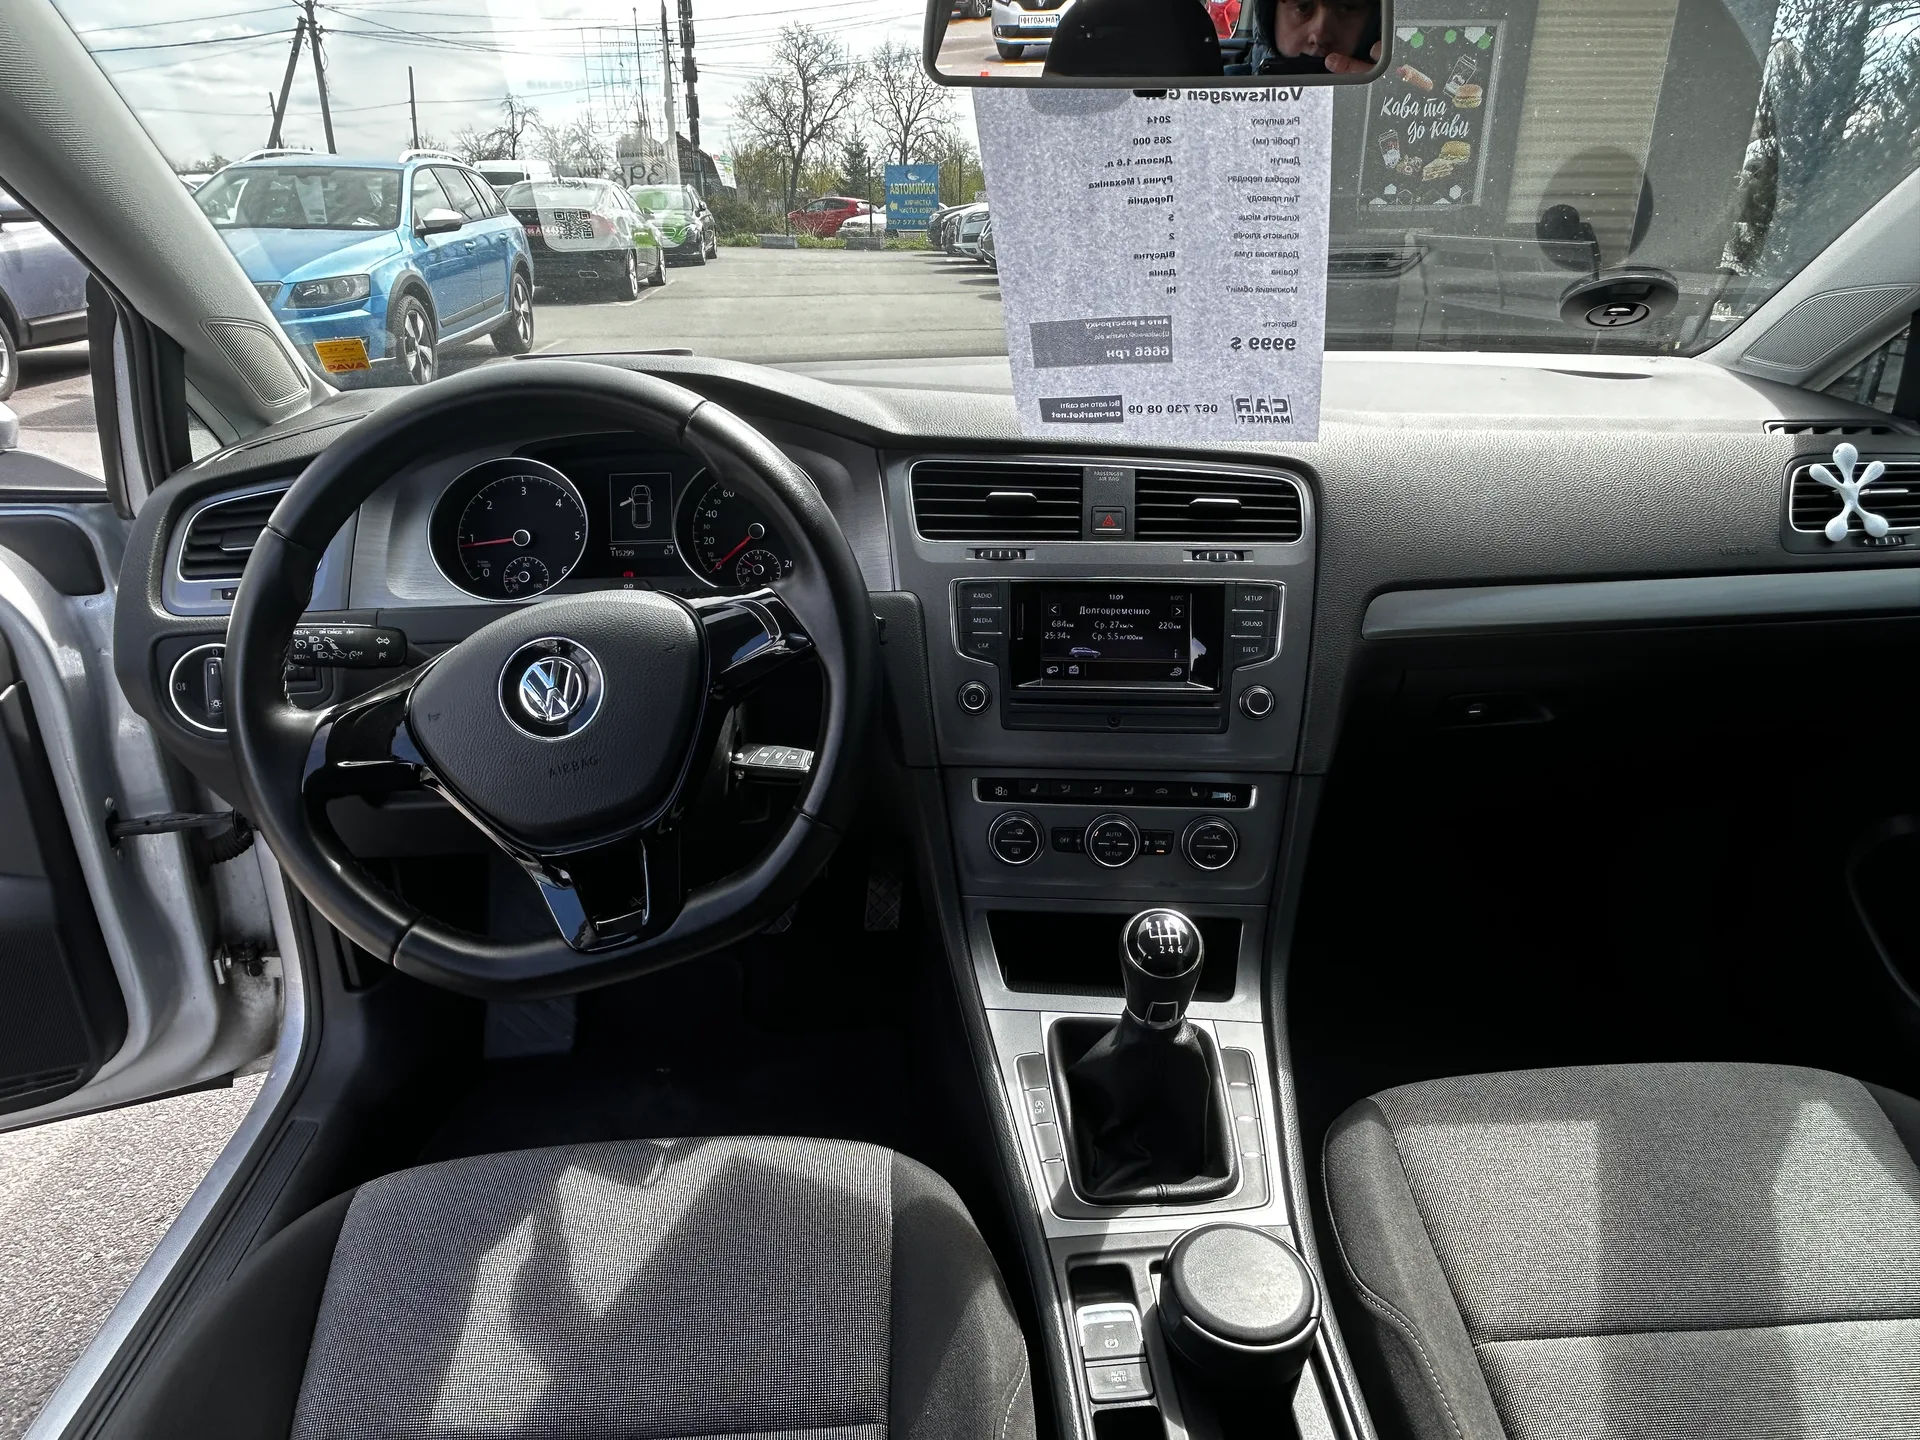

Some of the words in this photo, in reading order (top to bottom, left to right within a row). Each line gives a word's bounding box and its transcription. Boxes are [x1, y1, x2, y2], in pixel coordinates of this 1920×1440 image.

[1380, 93, 1420, 118] Кава
[1424, 97, 1447, 117] та
[1408, 119, 1425, 144] до
[1430, 114, 1470, 138] кави
[889, 182, 936, 194] АВТОМИЙКА
[521, 487, 527, 496] 3
[486, 501, 493, 510] 2
[555, 499, 562, 508] 4
[705, 510, 718, 518] 40
[574, 531, 580, 540] 5
[704, 537, 715, 545] 20
[483, 568, 490, 577] 0
[1079, 605, 1150, 616] Долговременно
[550, 754, 599, 779] AIRBAG
[1159, 946, 1165, 954] 2
[1168, 946, 1174, 954] 4
[1177, 946, 1183, 954] 6
